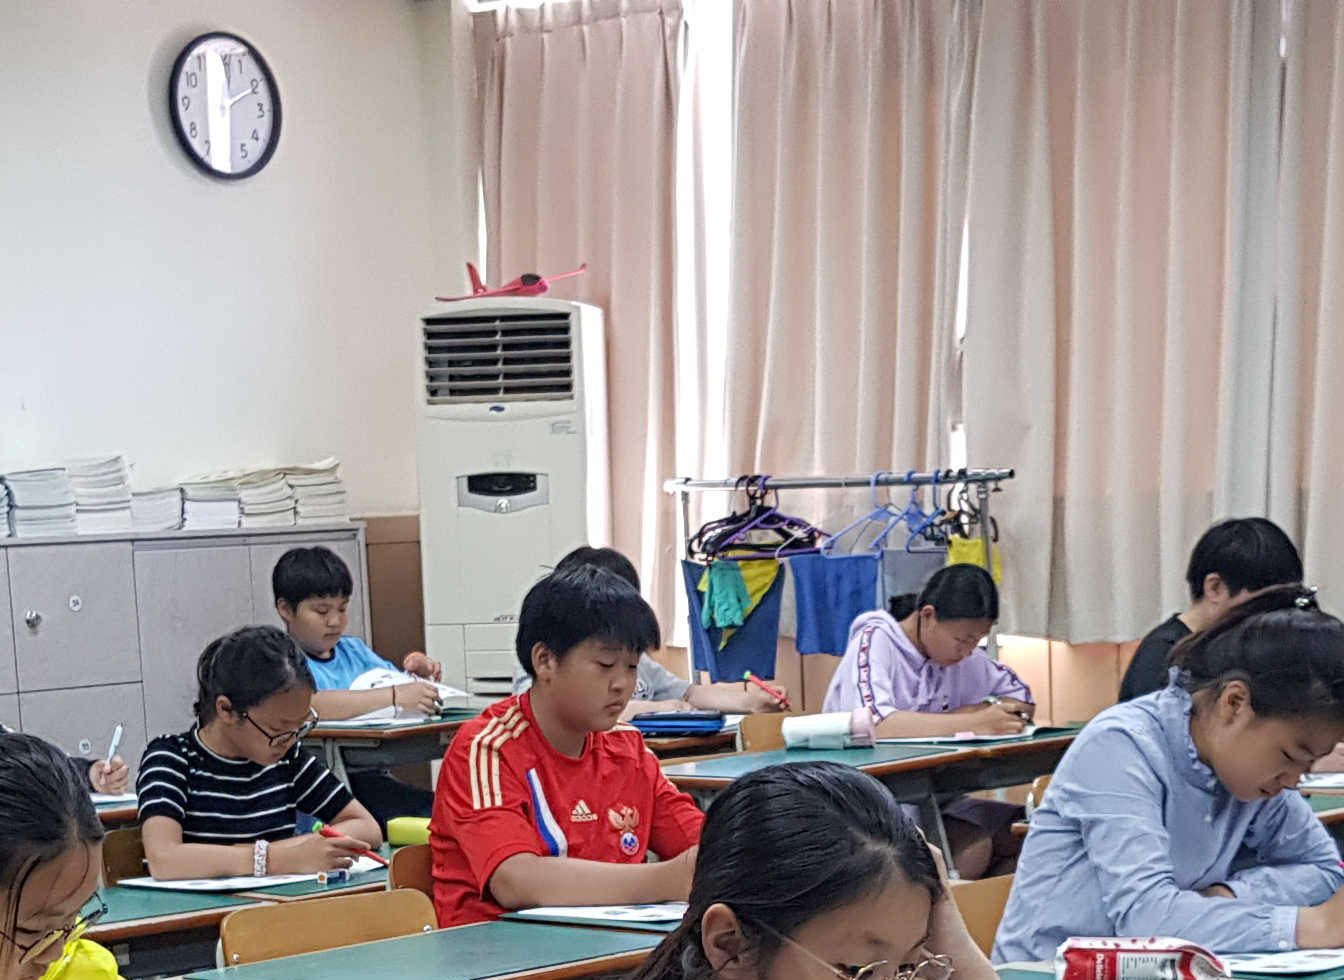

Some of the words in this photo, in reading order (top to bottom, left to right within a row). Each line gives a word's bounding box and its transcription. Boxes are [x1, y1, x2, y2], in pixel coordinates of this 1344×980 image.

[186, 71, 198, 88] 10
[250, 79, 259, 94] 2
[182, 96, 191, 111] 9
[257, 103, 265, 118] 3
[189, 121, 198, 138] 8
[251, 129, 259, 142] 4
[205, 140, 211, 156] 7
[240, 143, 248, 158] 5
